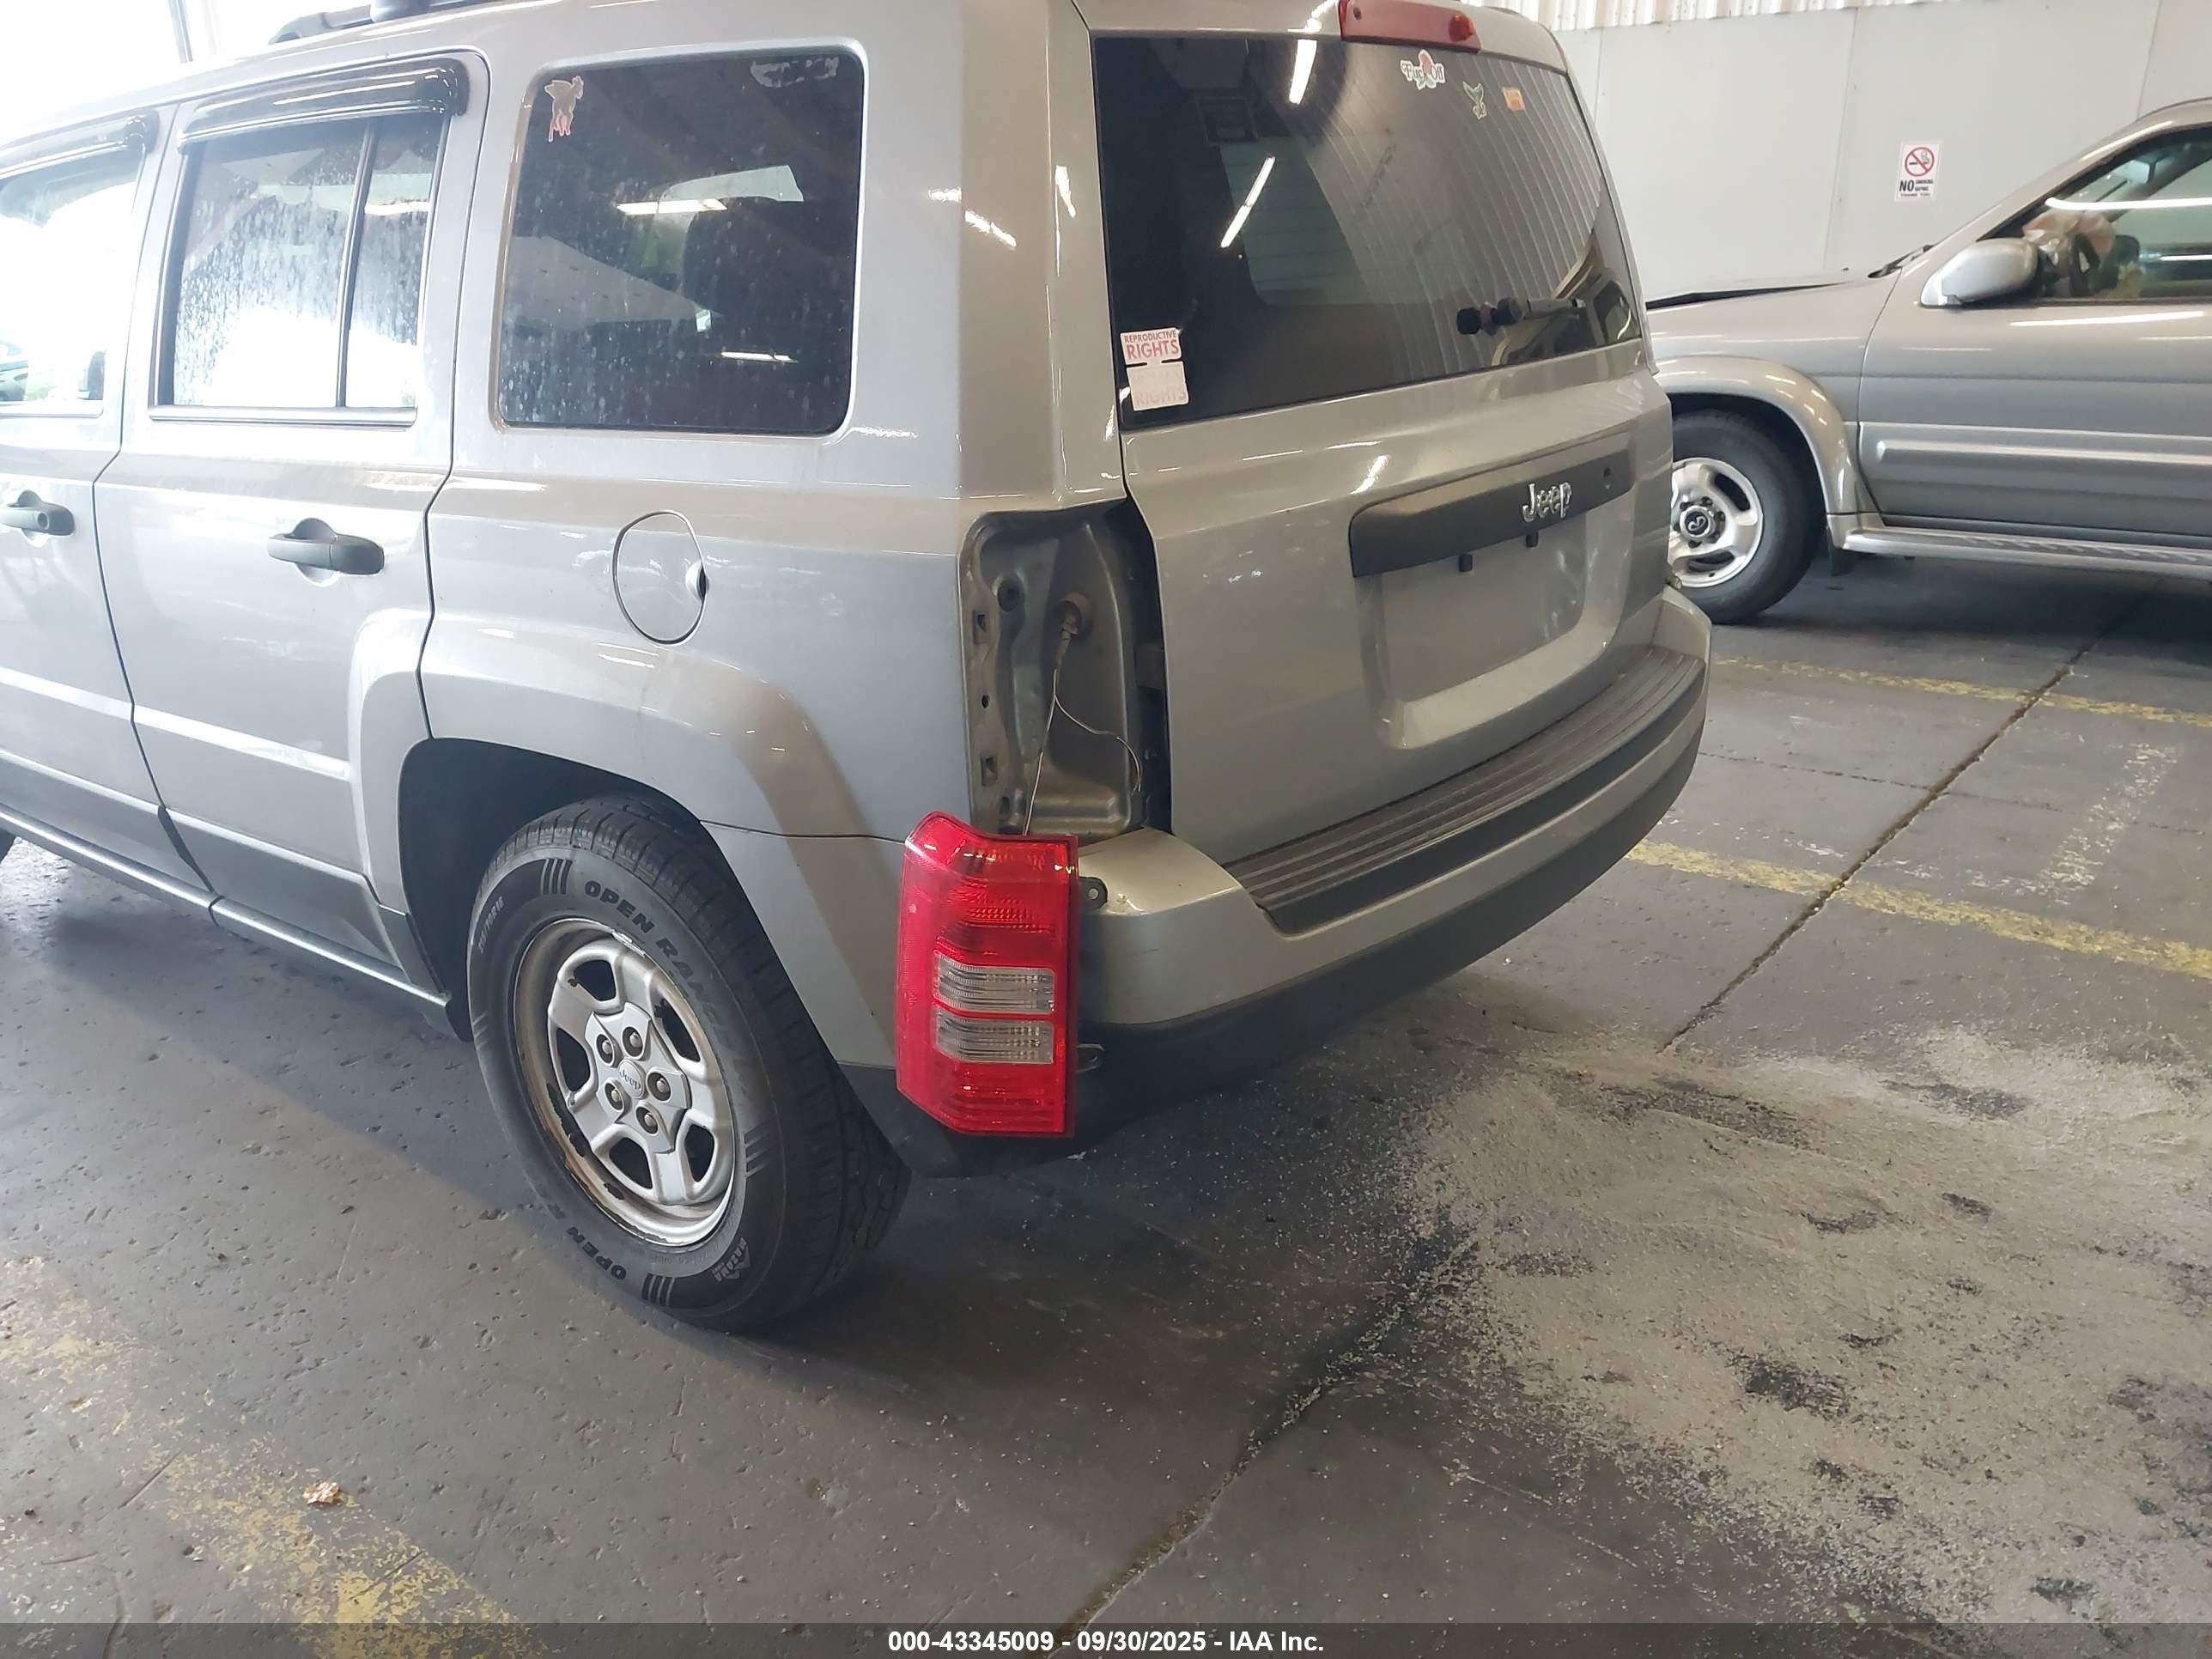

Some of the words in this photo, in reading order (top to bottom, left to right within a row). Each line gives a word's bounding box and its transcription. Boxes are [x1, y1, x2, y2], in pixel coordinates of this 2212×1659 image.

[1899, 179, 1915, 191] NO
[1124, 330, 1177, 343] REPRODUCTIVE
[1126, 339, 1180, 360] RIGHTS
[1522, 482, 1572, 522] Jeep
[585, 880, 655, 933] OPEN
[619, 1069, 641, 1091] Jeep
[566, 1226, 627, 1280] OPEN
